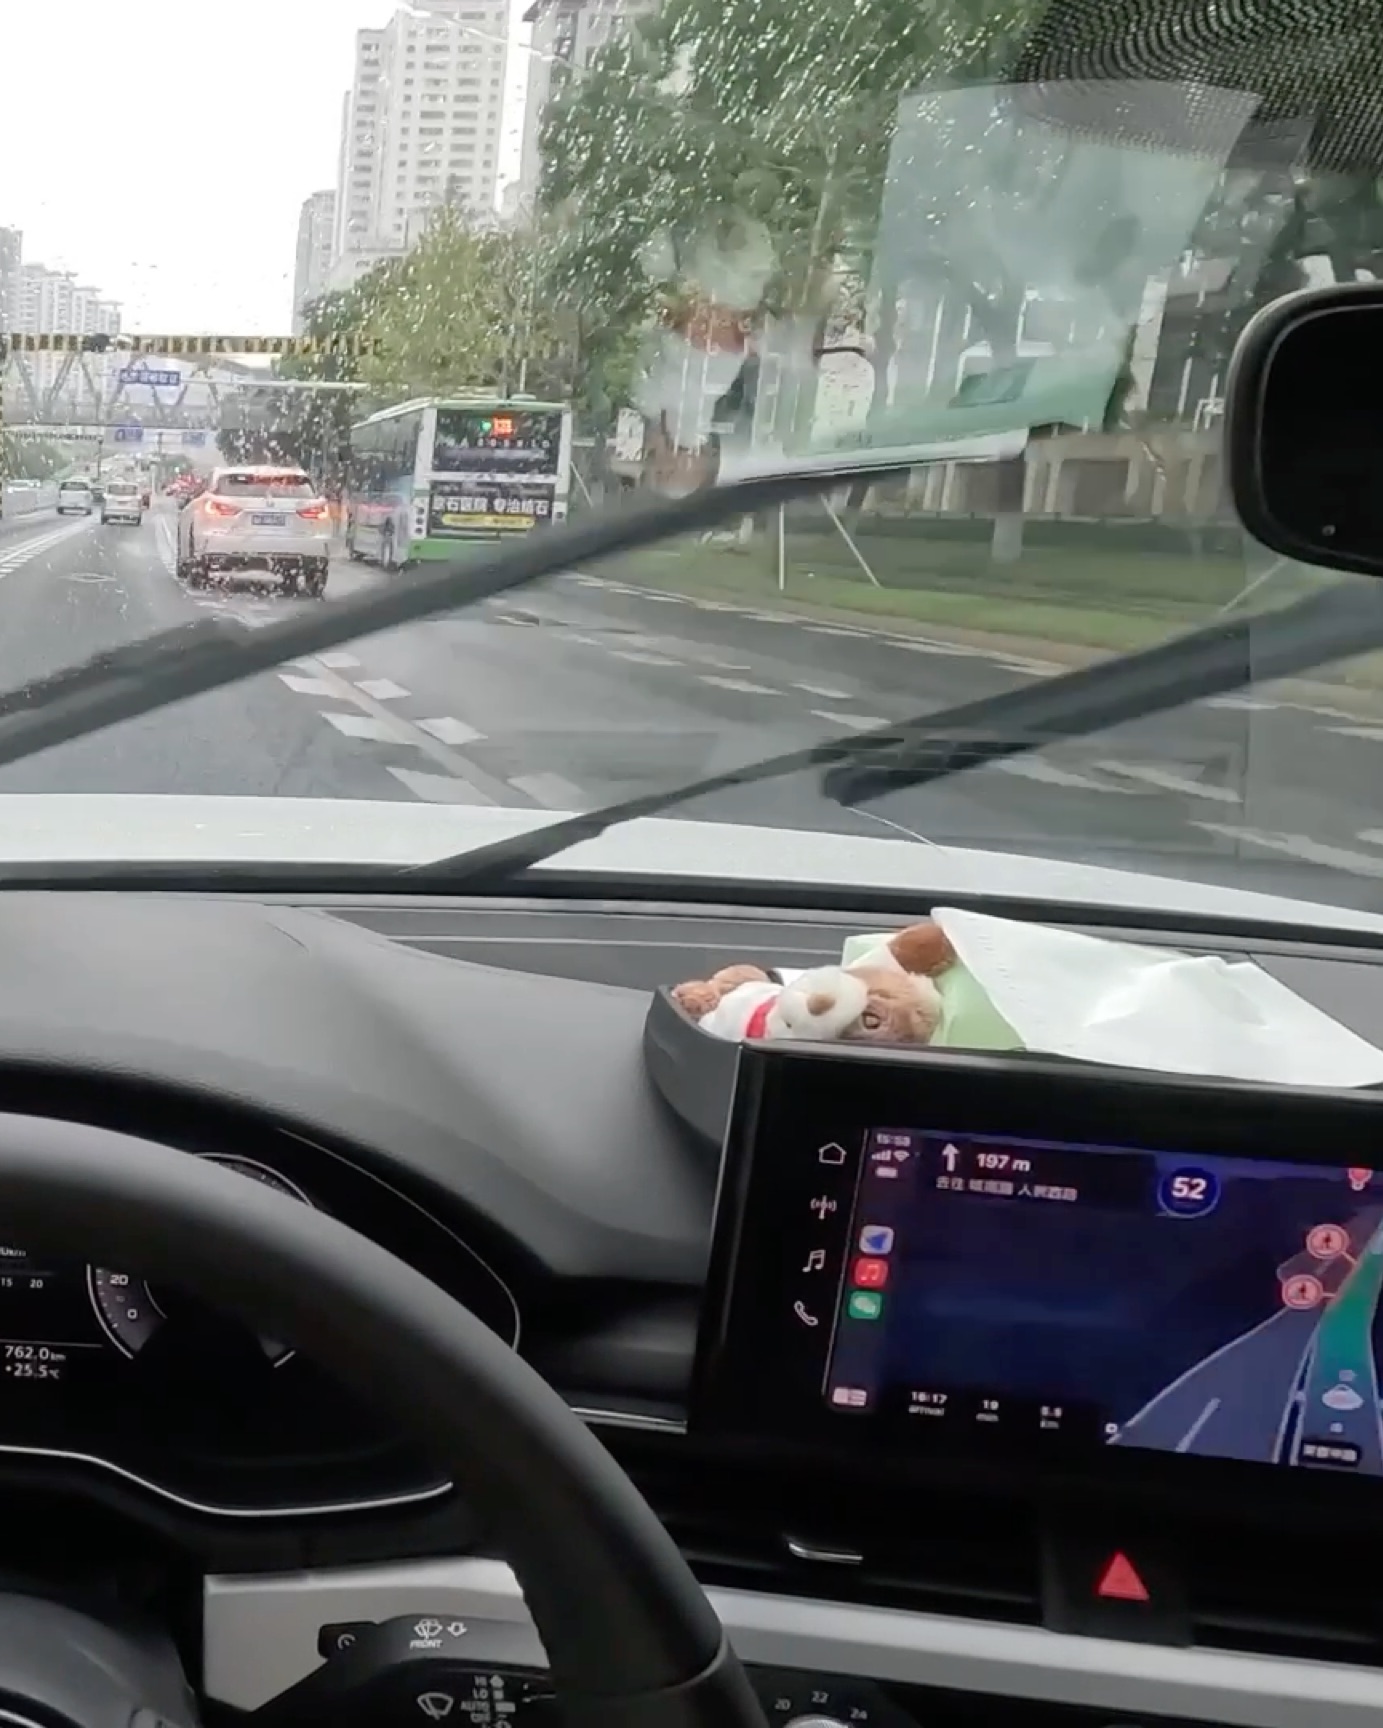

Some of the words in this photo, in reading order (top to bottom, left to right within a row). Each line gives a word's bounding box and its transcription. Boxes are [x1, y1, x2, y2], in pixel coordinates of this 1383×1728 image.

[976, 1153, 1008, 1169] 197
[1012, 1158, 1031, 1172] m
[1171, 1175, 1207, 1201] 52
[1, 1277, 13, 1288] 15
[29, 1278, 44, 1289] 20
[109, 1274, 129, 1286] 20
[127, 1308, 137, 1320] 0
[410, 1639, 443, 1650] FRONT
[472, 1687, 488, 1700] LO
[811, 1690, 829, 1704] 22
[460, 1700, 491, 1713] AUTO
[775, 1698, 792, 1711] 20
